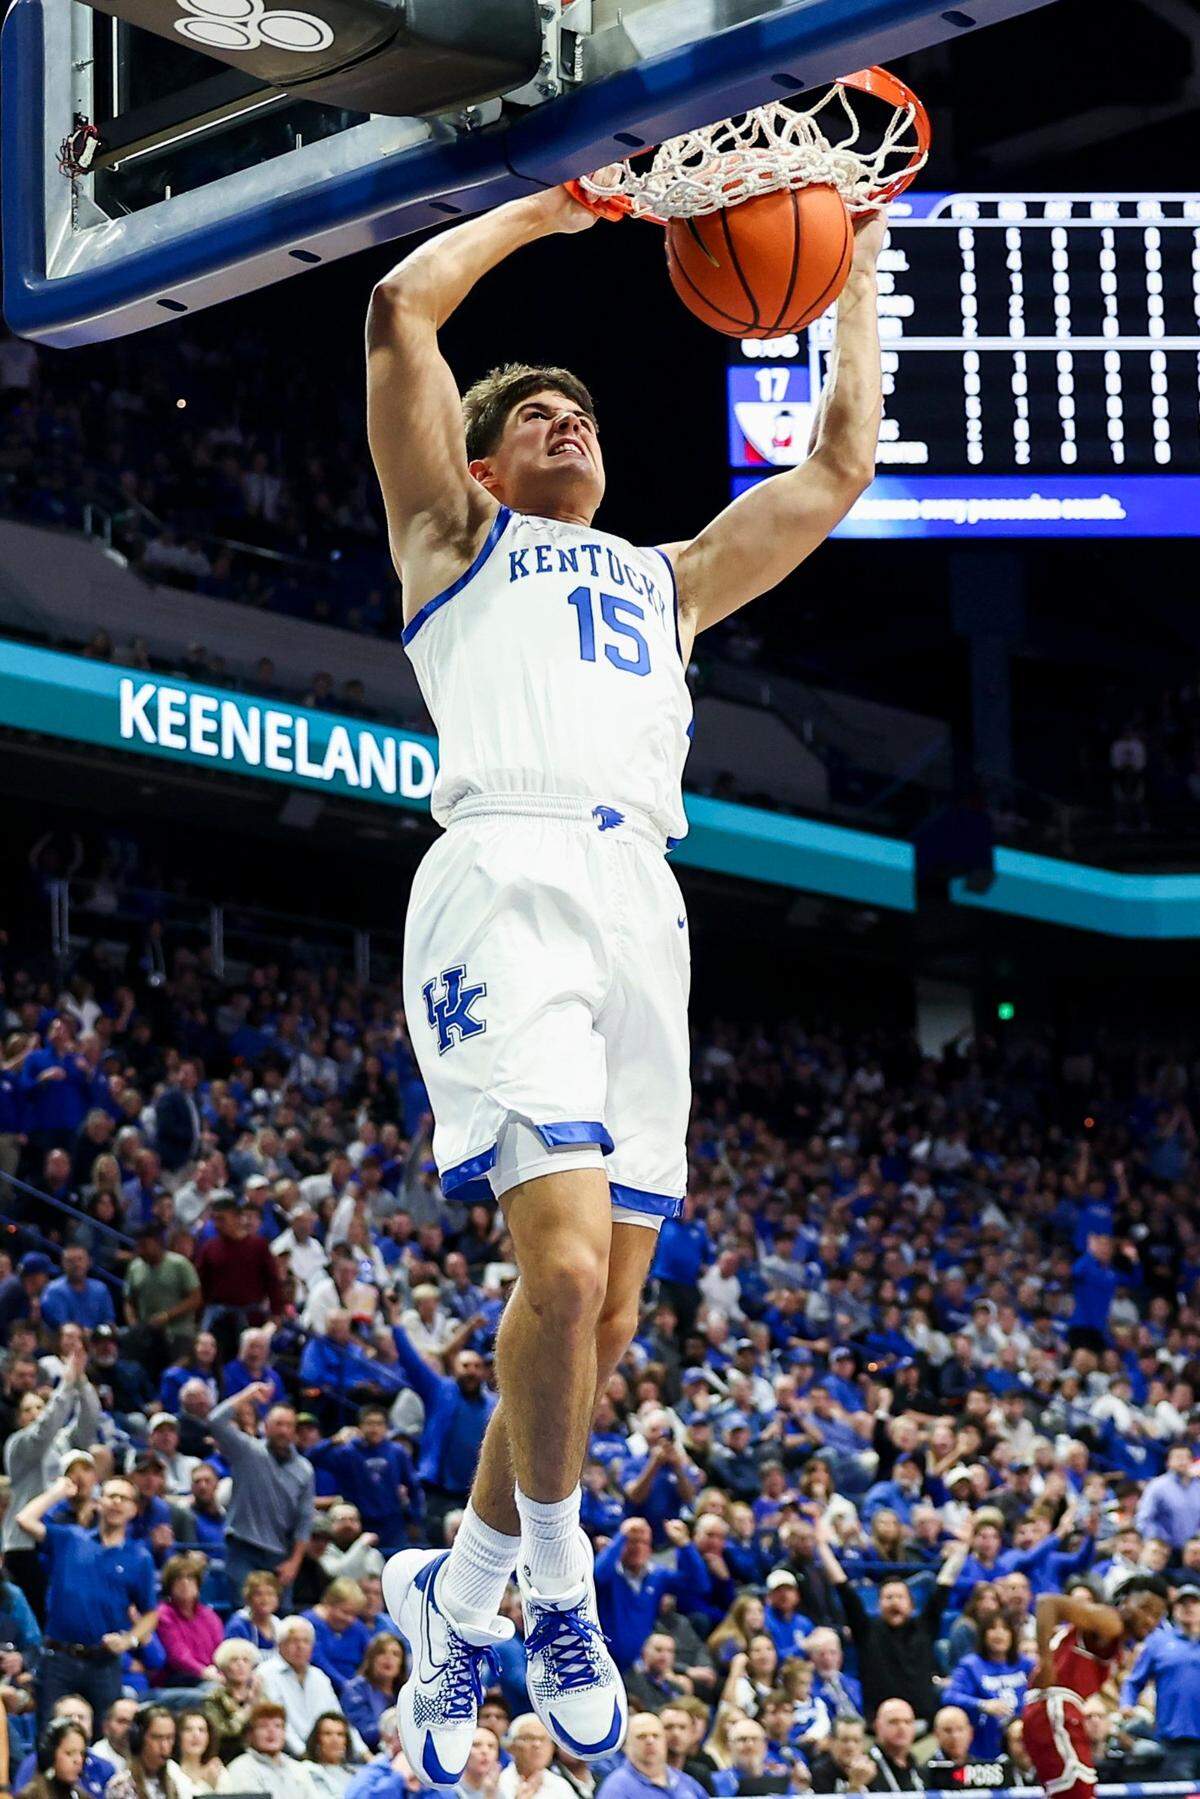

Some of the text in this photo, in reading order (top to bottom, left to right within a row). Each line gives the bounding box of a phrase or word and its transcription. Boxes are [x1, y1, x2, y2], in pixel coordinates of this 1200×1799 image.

[754, 367, 791, 402] 17
[509, 543, 667, 633] KENTUCKY
[567, 585, 652, 677] 15
[119, 678, 436, 799] KEENELAND
[422, 964, 487, 1056] UK
